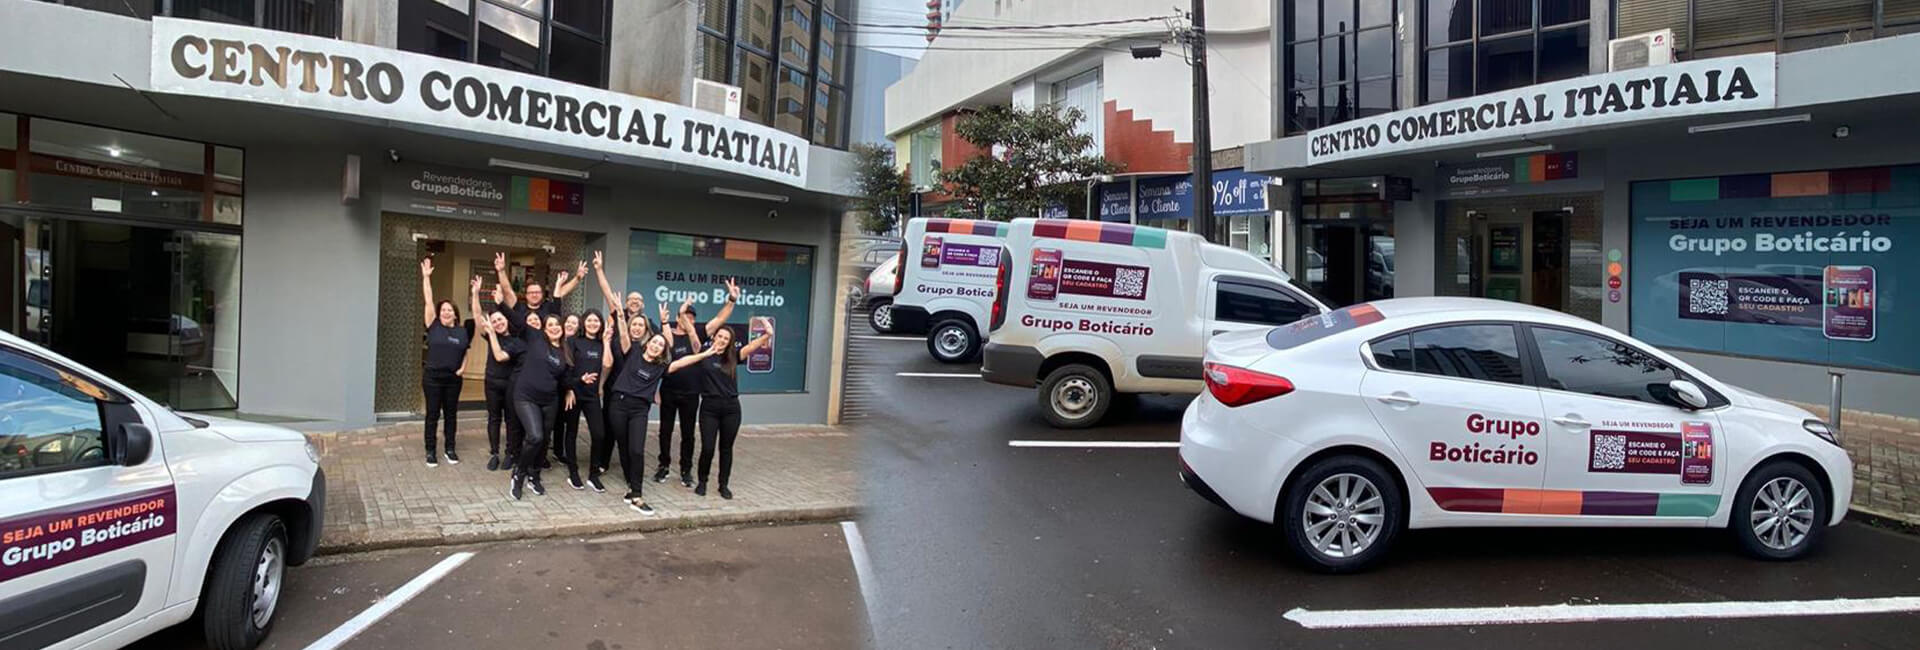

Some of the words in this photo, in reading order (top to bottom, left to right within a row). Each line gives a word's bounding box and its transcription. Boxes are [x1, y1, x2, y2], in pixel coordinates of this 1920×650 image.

[170, 34, 404, 104] CENTRO
[419, 70, 672, 149] COMERCIAL
[681, 119, 802, 177] ITATIAIA
[1311, 124, 1381, 158] CENTRO
[1386, 94, 1553, 143] COMERCIAL
[1563, 66, 1759, 118] ITATIAIA
[423, 171, 493, 189] Revendedores
[1450, 172, 1510, 184] GrupoBoticário
[411, 179, 503, 200] GrupoBoticário
[1233, 178, 1247, 204] off
[1669, 218, 1710, 230] SEJA
[1716, 217, 1744, 229] UM
[1751, 213, 1891, 228] REVENDEDOR
[1669, 234, 1747, 256] Grupo
[1755, 230, 1892, 252] Boticário
[656, 270, 685, 282] SEJA
[689, 272, 708, 283] UM
[655, 285, 708, 304] Grupo
[917, 284, 953, 296] Grupo
[957, 286, 994, 297] Boticá
[1738, 287, 1780, 295] ESCANEIE
[1097, 305, 1152, 315] REVENDEDOR
[1757, 304, 1804, 312] CADASTRO
[1786, 297, 1810, 305] FAÇA
[1021, 315, 1073, 332] Grupo
[1079, 320, 1154, 336] Boticário
[1466, 413, 1540, 439] Grupo
[1430, 442, 1538, 465] Boticário
[1663, 451, 1680, 459] FAÇA
[3, 526, 44, 544] SEJA
[48, 518, 73, 533] UM
[77, 499, 165, 527] REVENDEDOR
[2, 537, 76, 566] Grupo
[81, 513, 165, 547] Boticário
